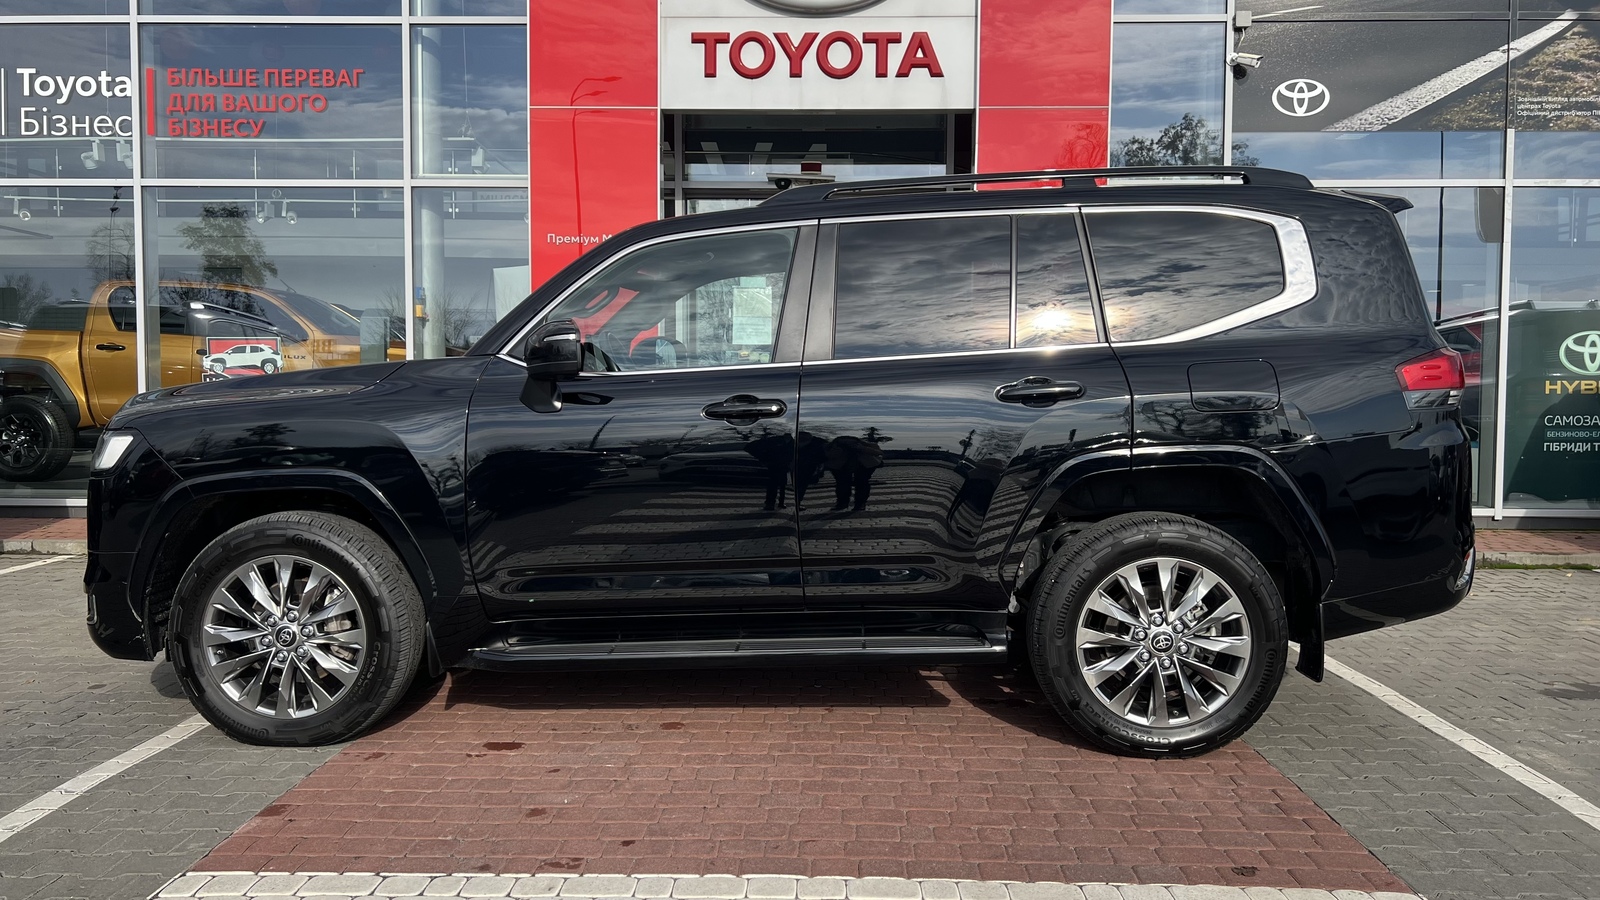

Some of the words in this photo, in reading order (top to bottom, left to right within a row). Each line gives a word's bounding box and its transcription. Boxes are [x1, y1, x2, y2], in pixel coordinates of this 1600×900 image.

[691, 30, 945, 79] TOYOTA
[16, 67, 132, 104] Toyota
[166, 68, 258, 87] БІЛЬШЕ
[263, 68, 364, 87] ПЕРЕВАГ
[166, 93, 216, 114] ДЛЯ
[221, 93, 328, 112] ВАШОГО
[20, 106, 133, 136] Бізнес
[168, 118, 265, 137] БІЗНЕСУ
[547, 233, 599, 246] Преміум
[1545, 380, 1600, 394] HYB
[1544, 415, 1600, 426] САМОЗА
[1543, 442, 1591, 453] ГІБРИДИ
[1053, 573, 1087, 640] Continental
